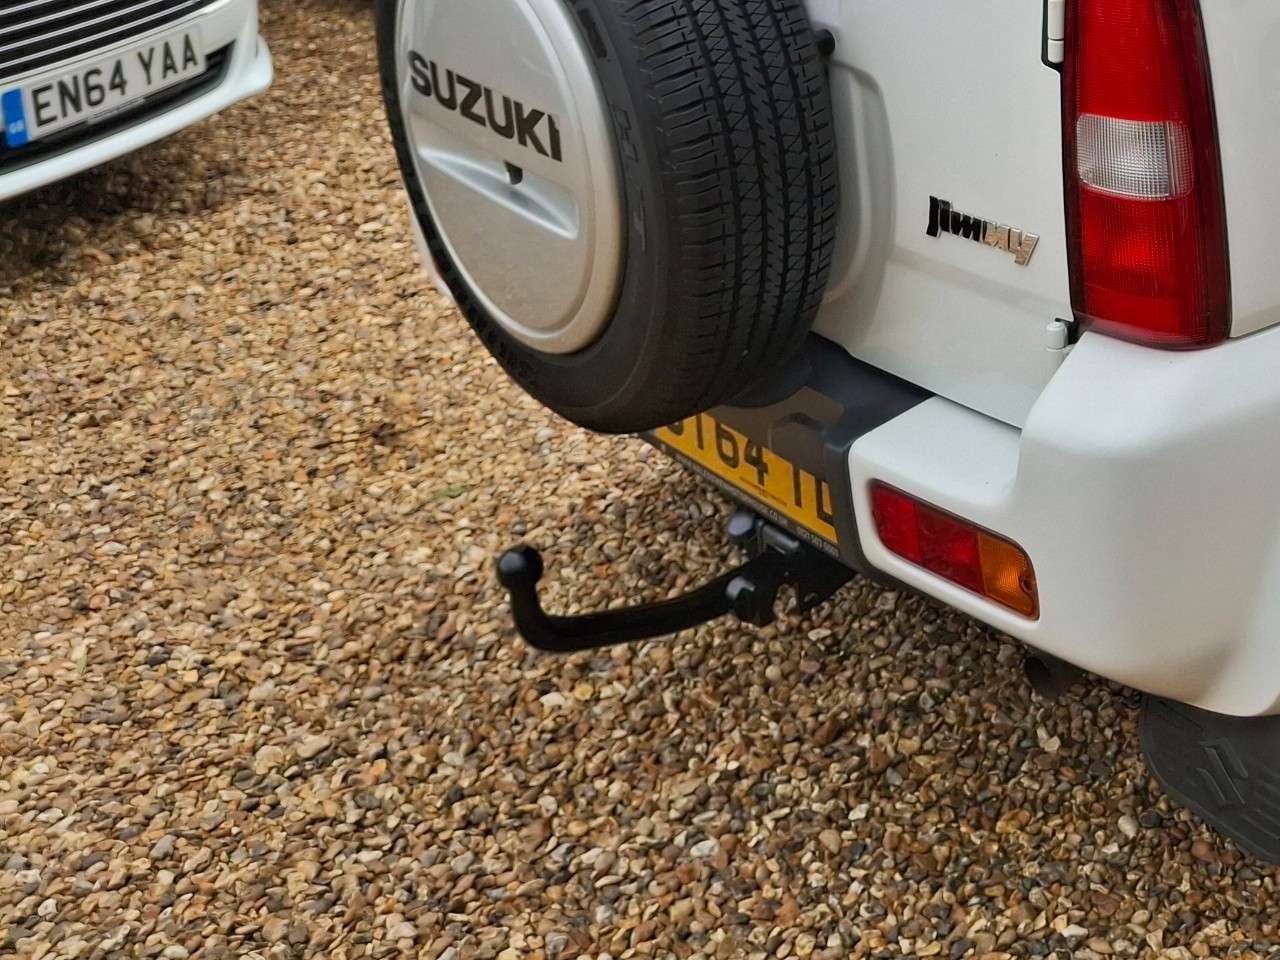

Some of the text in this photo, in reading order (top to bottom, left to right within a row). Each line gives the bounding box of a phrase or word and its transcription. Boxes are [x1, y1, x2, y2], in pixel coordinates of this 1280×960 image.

[32, 34, 199, 128] EN64 YAA
[408, 50, 563, 162] SUZUKI
